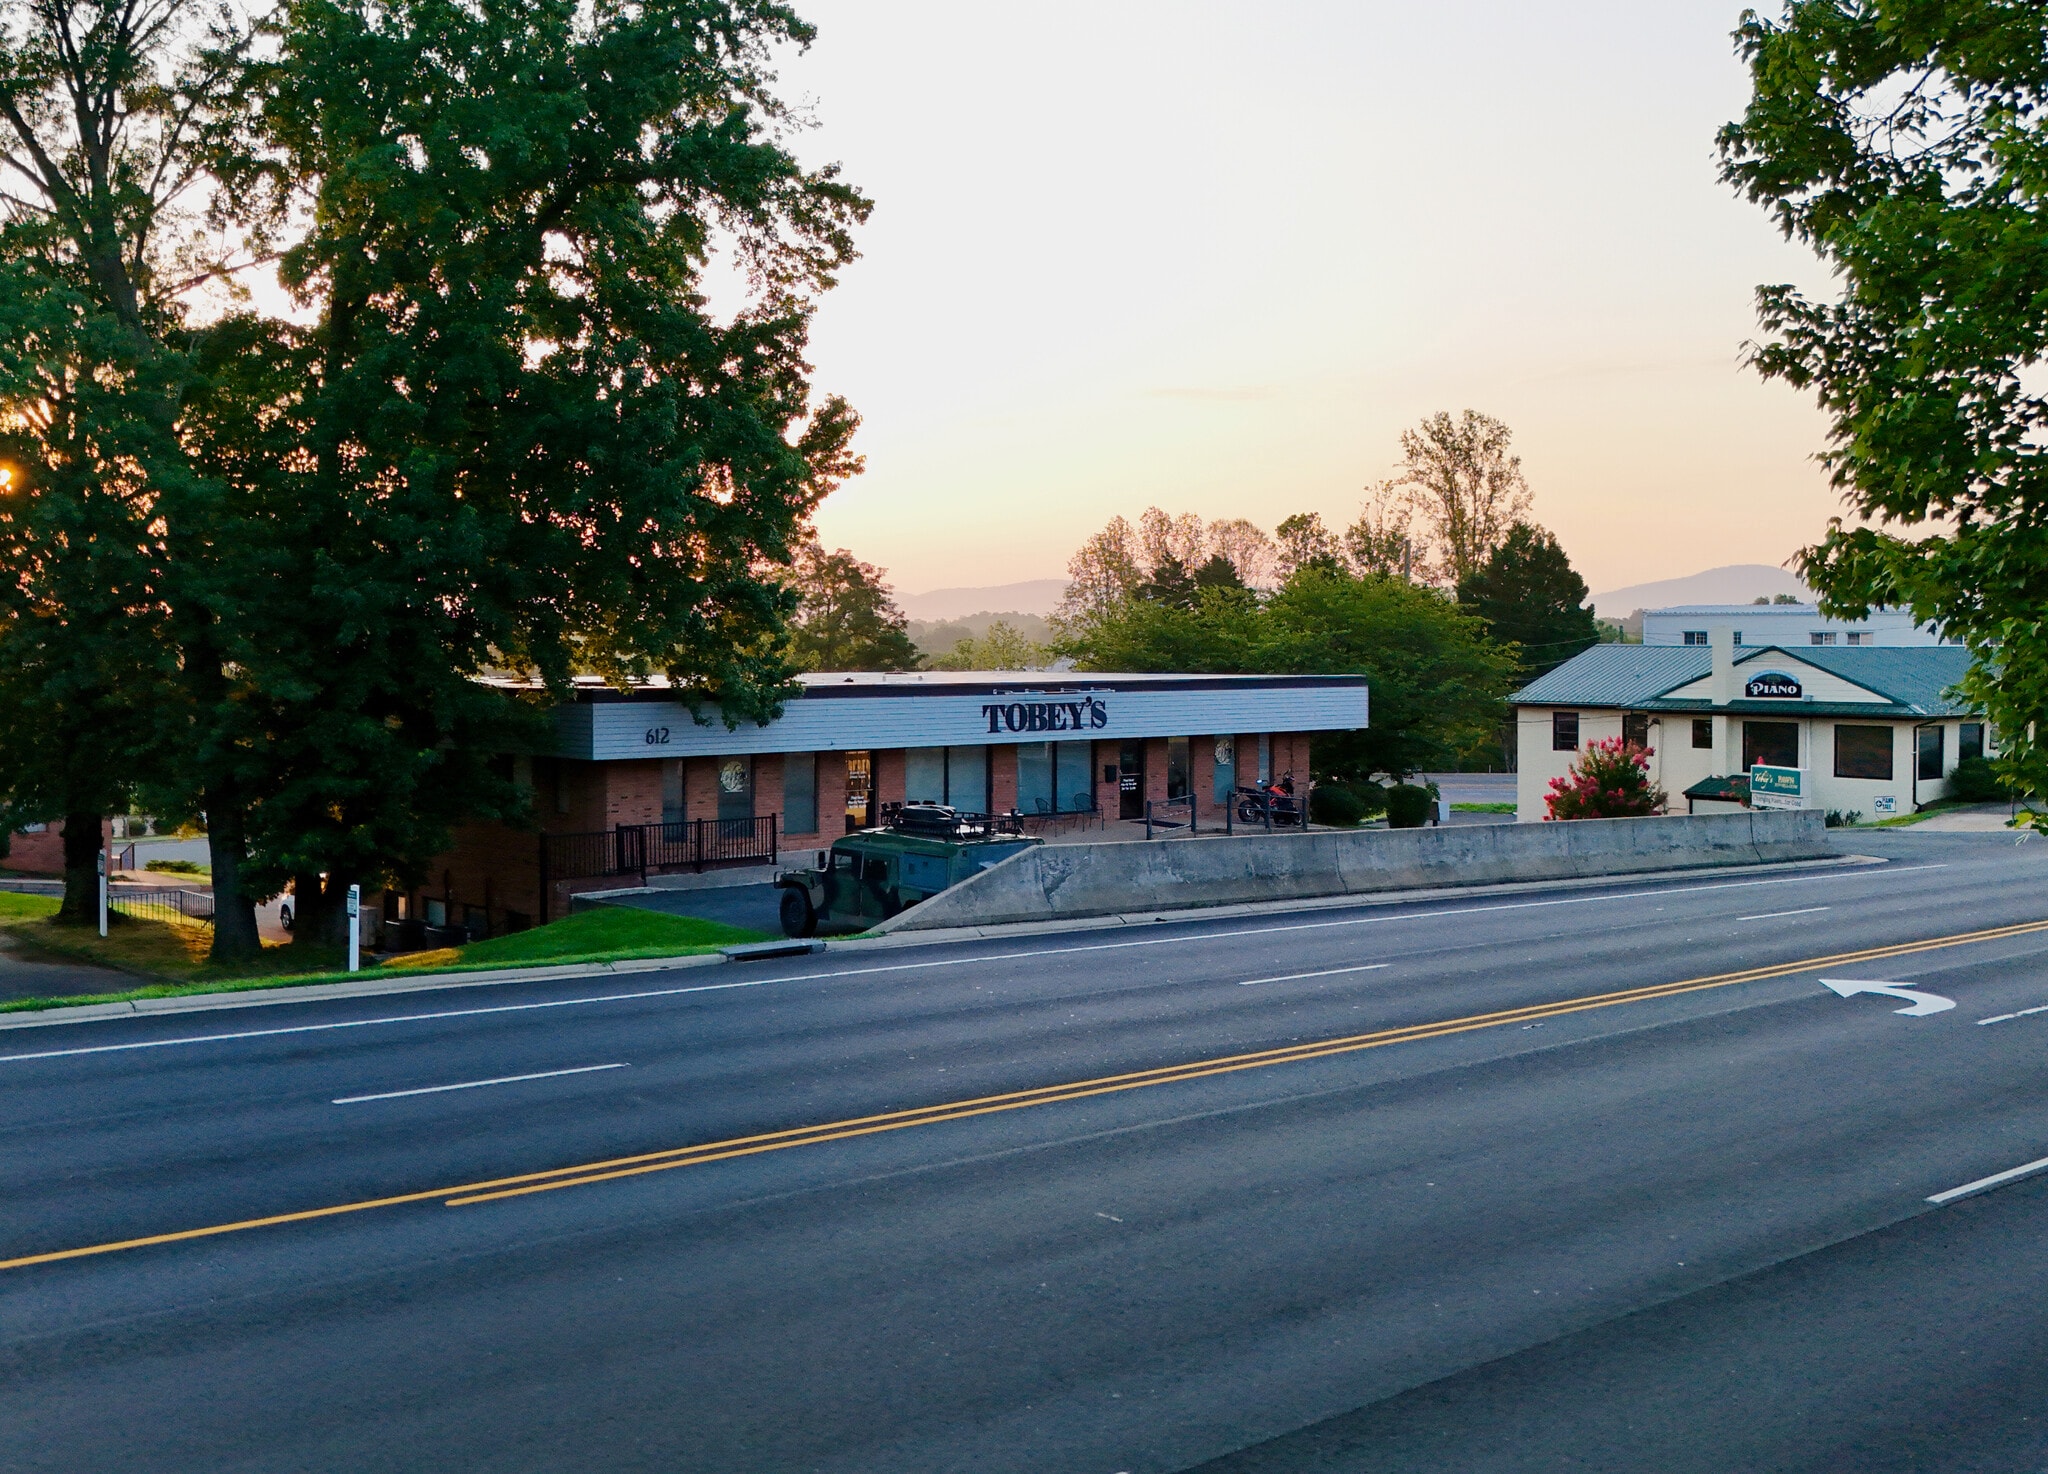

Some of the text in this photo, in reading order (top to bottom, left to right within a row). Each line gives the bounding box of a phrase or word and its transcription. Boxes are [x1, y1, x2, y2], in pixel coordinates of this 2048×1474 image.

[1750, 683, 1798, 695] PIANO
[982, 696, 1108, 733] TOBEY'S
[645, 727, 670, 745] 612
